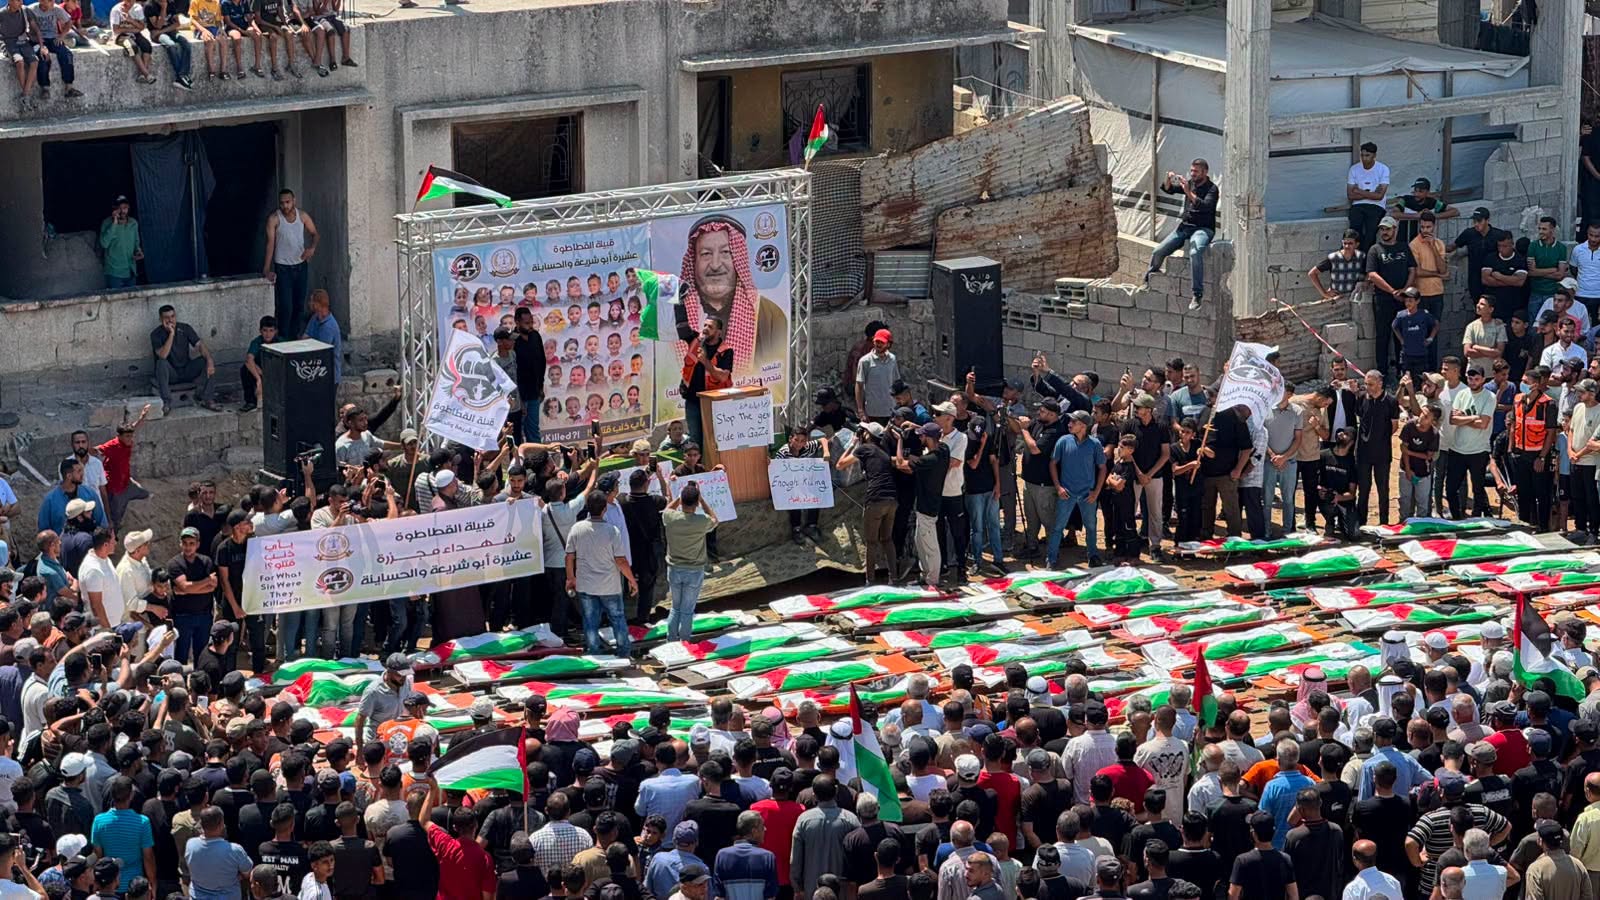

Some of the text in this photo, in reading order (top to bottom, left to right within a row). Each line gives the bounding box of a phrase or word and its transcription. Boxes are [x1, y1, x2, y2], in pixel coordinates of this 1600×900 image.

[554, 239, 614, 254] قبيلة القطاطوة
[532, 251, 638, 272] عشيرة أبو شريعة والحساينة
[716, 412, 735, 426] Stop
[772, 476, 799, 492] Enough
[395, 518, 495, 542] قبيلة القطاطوة
[376, 533, 516, 564] شهداء مجزرة
[360, 551, 532, 586] عشيرة أبو شريعة والحساينة
